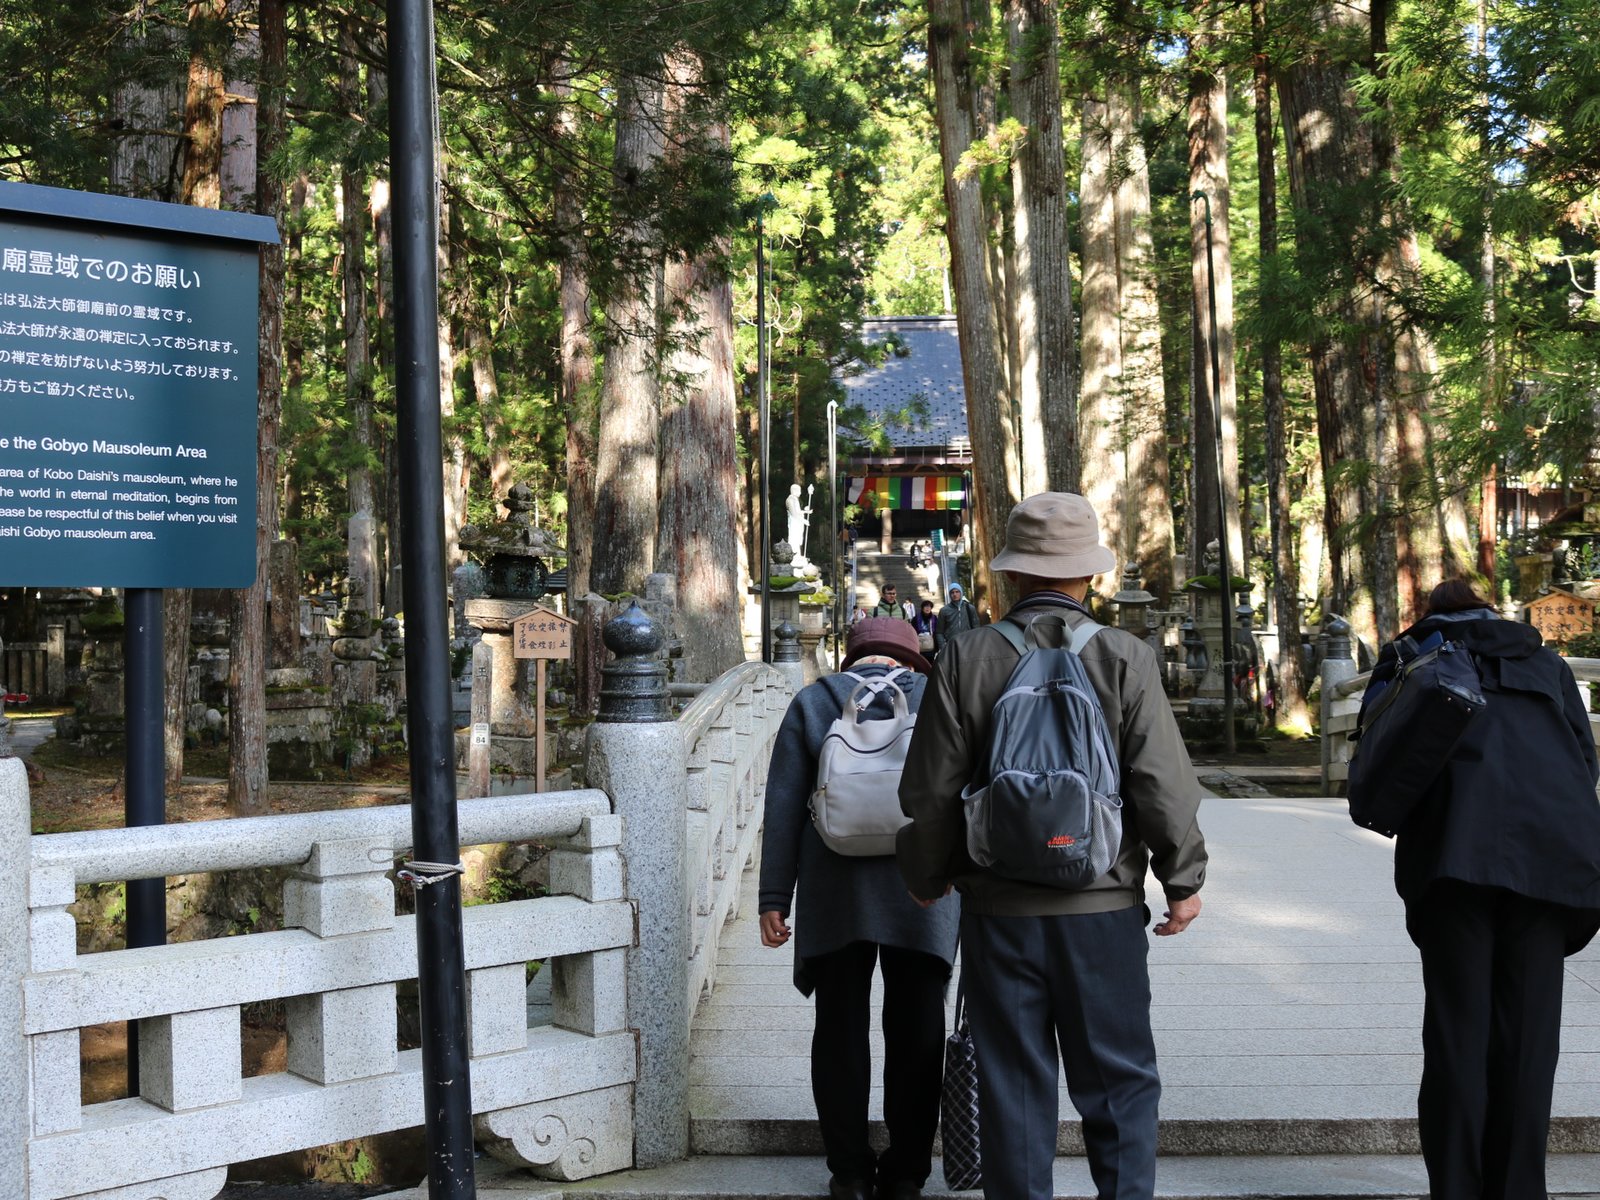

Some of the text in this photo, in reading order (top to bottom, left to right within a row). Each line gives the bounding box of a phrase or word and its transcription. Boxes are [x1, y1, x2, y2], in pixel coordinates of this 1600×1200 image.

[2, 247, 201, 290] 廟霊域でのお願い
[0, 320, 239, 355] 法大師が永遠の禅定に入っておられます。
[0, 378, 135, 401] 方もご協力ください。
[13, 436, 37, 450] the
[41, 437, 88, 455] Gobyo
[92, 440, 172, 457] Mausoleum
[175, 444, 207, 459] Area
[0, 468, 238, 487] area of Kobo Daishi's mausoleum, where he
[19, 488, 51, 499] world
[55, 488, 66, 499] in
[70, 489, 108, 501] eternal
[112, 491, 171, 504] meditation,
[175, 493, 210, 506] begins
[214, 494, 238, 505] from
[28, 507, 43, 518] be
[45, 508, 100, 521] respectful
[102, 508, 113, 520] of
[115, 509, 134, 521] this
[136, 510, 165, 521] belief
[167, 512, 195, 522] when
[197, 514, 216, 525] you
[218, 513, 238, 523] visit
[0, 526, 157, 541] ishi Gobyo mausoleum area.
